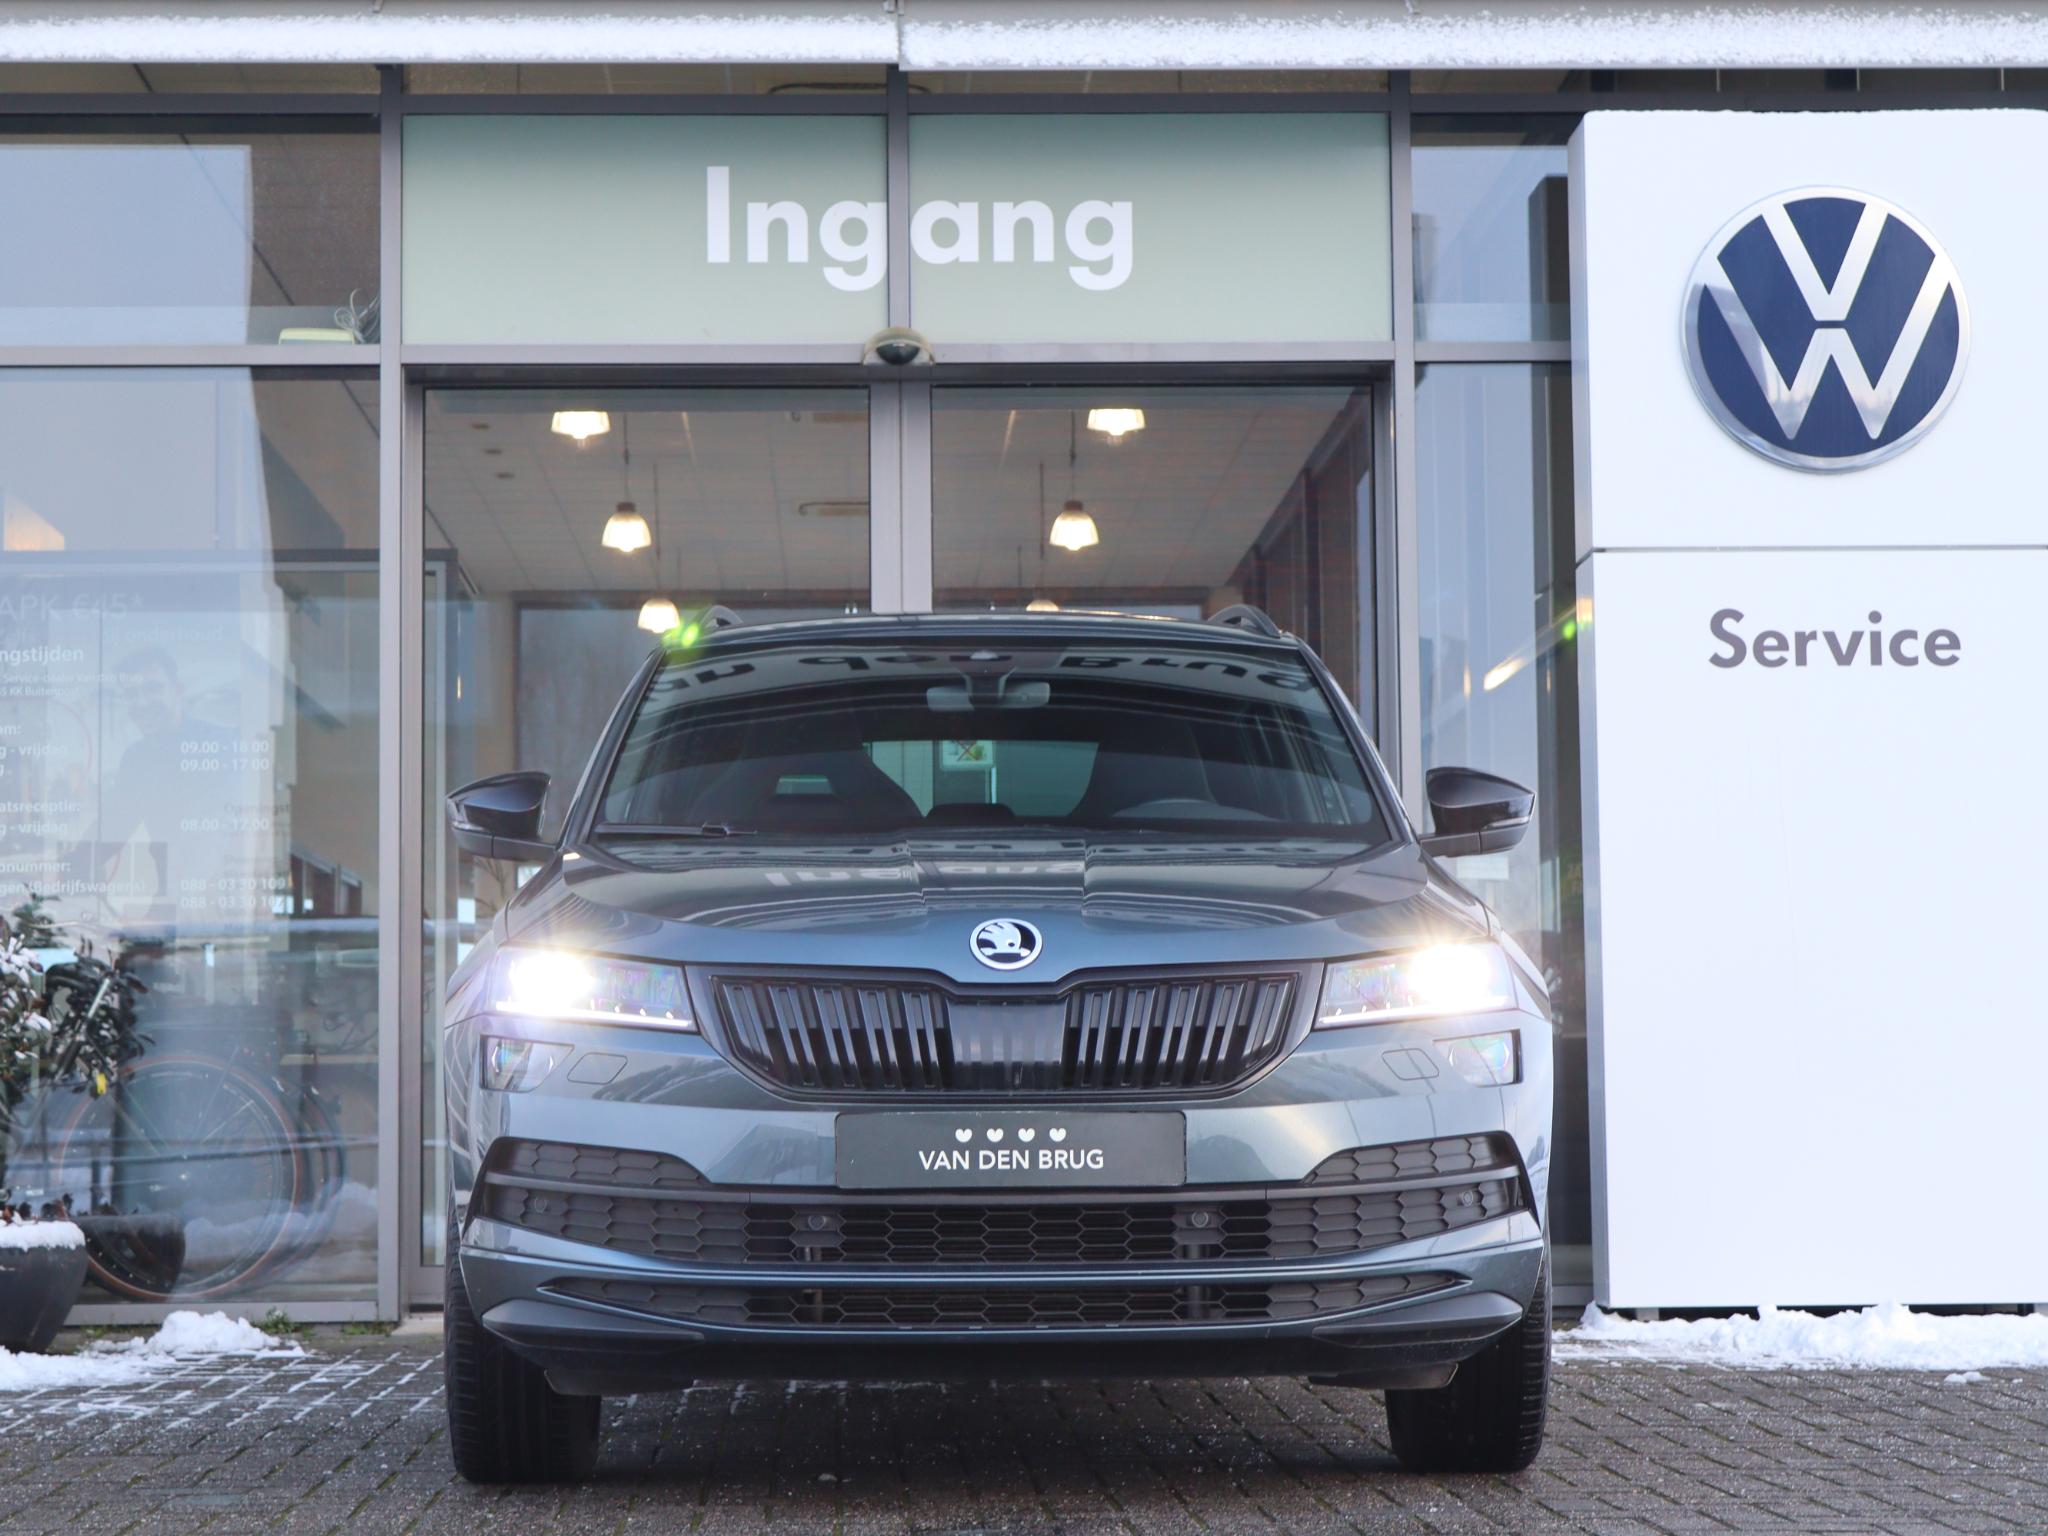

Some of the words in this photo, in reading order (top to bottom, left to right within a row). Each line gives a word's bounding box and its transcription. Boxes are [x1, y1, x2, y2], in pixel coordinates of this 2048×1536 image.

[707, 166, 1133, 291] Ingang
[0, 594, 62, 621] APK
[1708, 608, 1962, 667] Service
[0, 646, 84, 667] ngstijden
[18, 744, 70, 759] vrijdag
[179, 741, 220, 753] 09.00
[179, 758, 221, 771] 09.00
[18, 821, 69, 837] vrijdag
[918, 1150, 970, 1171] VAN
[978, 1150, 1030, 1170] DEN
[1038, 1149, 1104, 1170] BRUG
